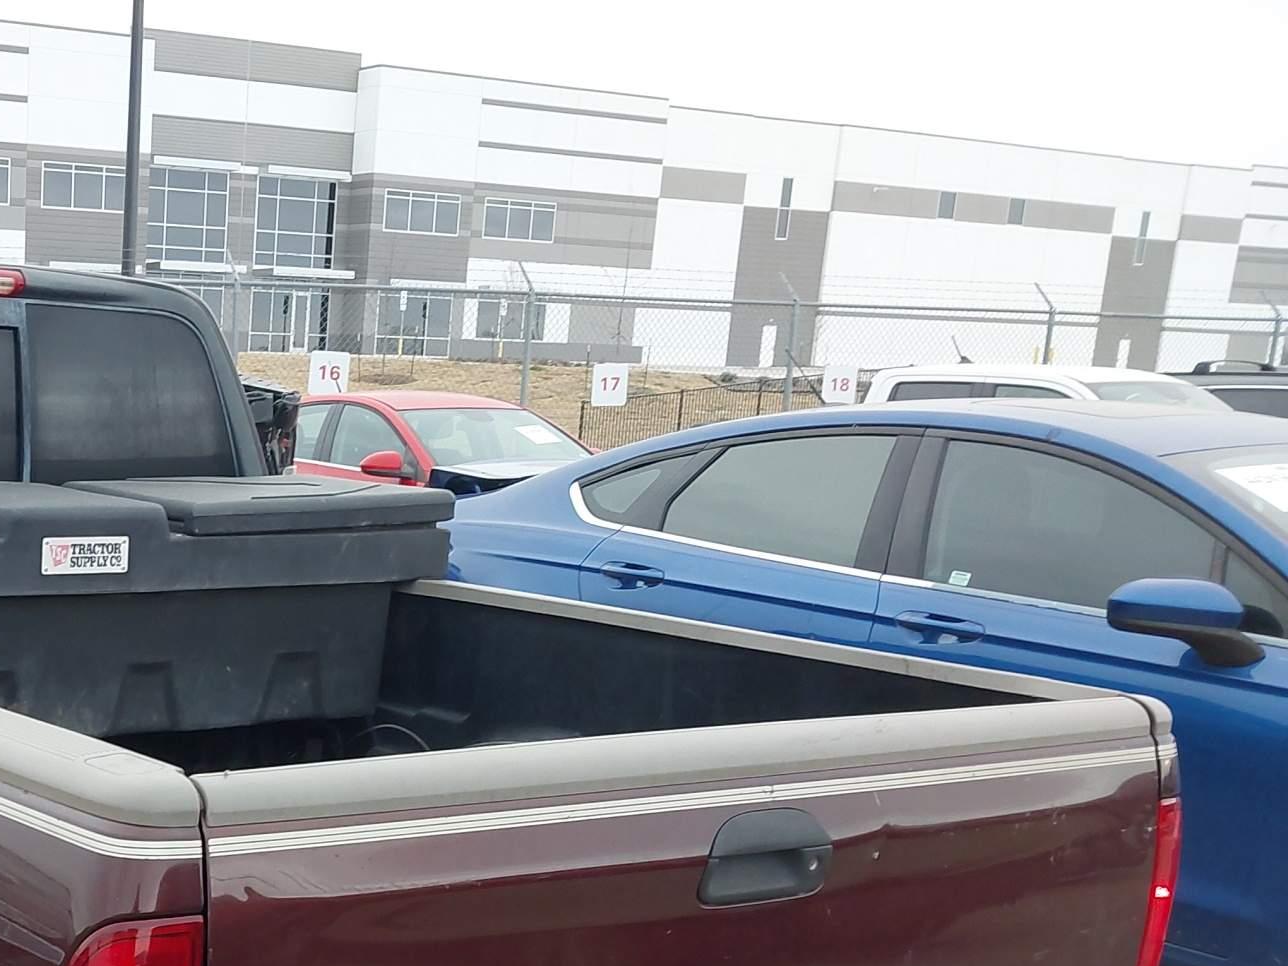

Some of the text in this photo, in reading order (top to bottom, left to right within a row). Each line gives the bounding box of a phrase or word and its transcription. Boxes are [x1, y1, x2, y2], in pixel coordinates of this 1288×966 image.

[319, 365, 341, 381] 16
[601, 377, 621, 391] 17
[831, 377, 850, 392] 18
[70, 543, 122, 555] TRACTOR
[70, 556, 109, 568] SUPPLY
